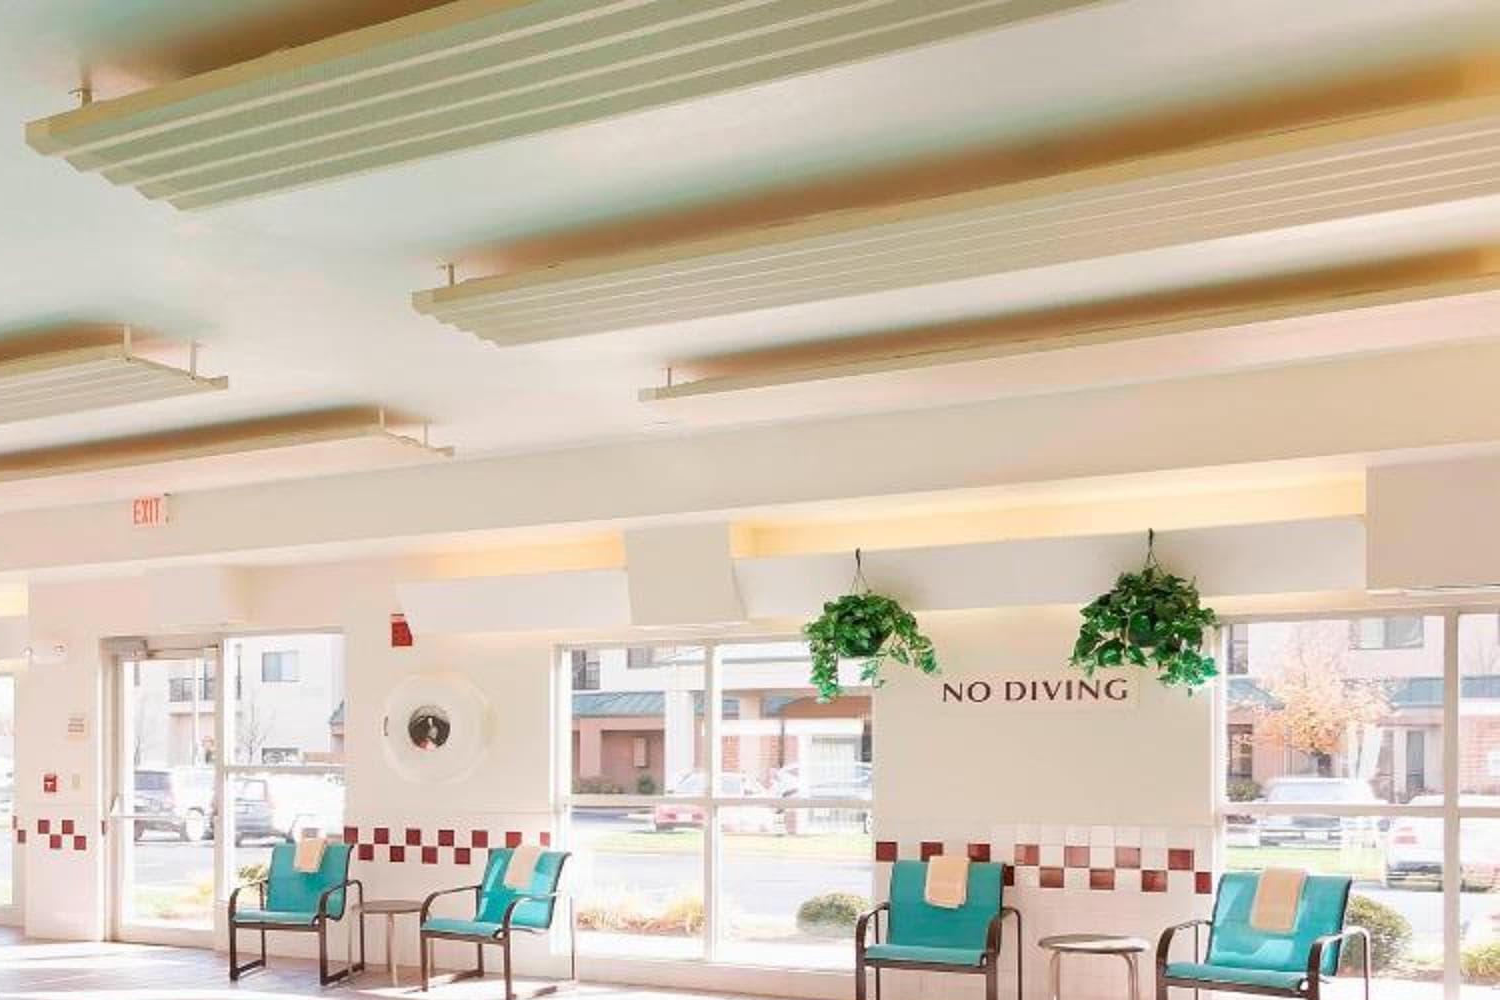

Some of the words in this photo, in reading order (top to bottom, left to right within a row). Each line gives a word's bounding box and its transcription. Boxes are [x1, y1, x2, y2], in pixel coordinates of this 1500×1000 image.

[133, 497, 161, 525] EXIT
[943, 681, 992, 703] NO
[1005, 678, 1127, 701] DIVING
